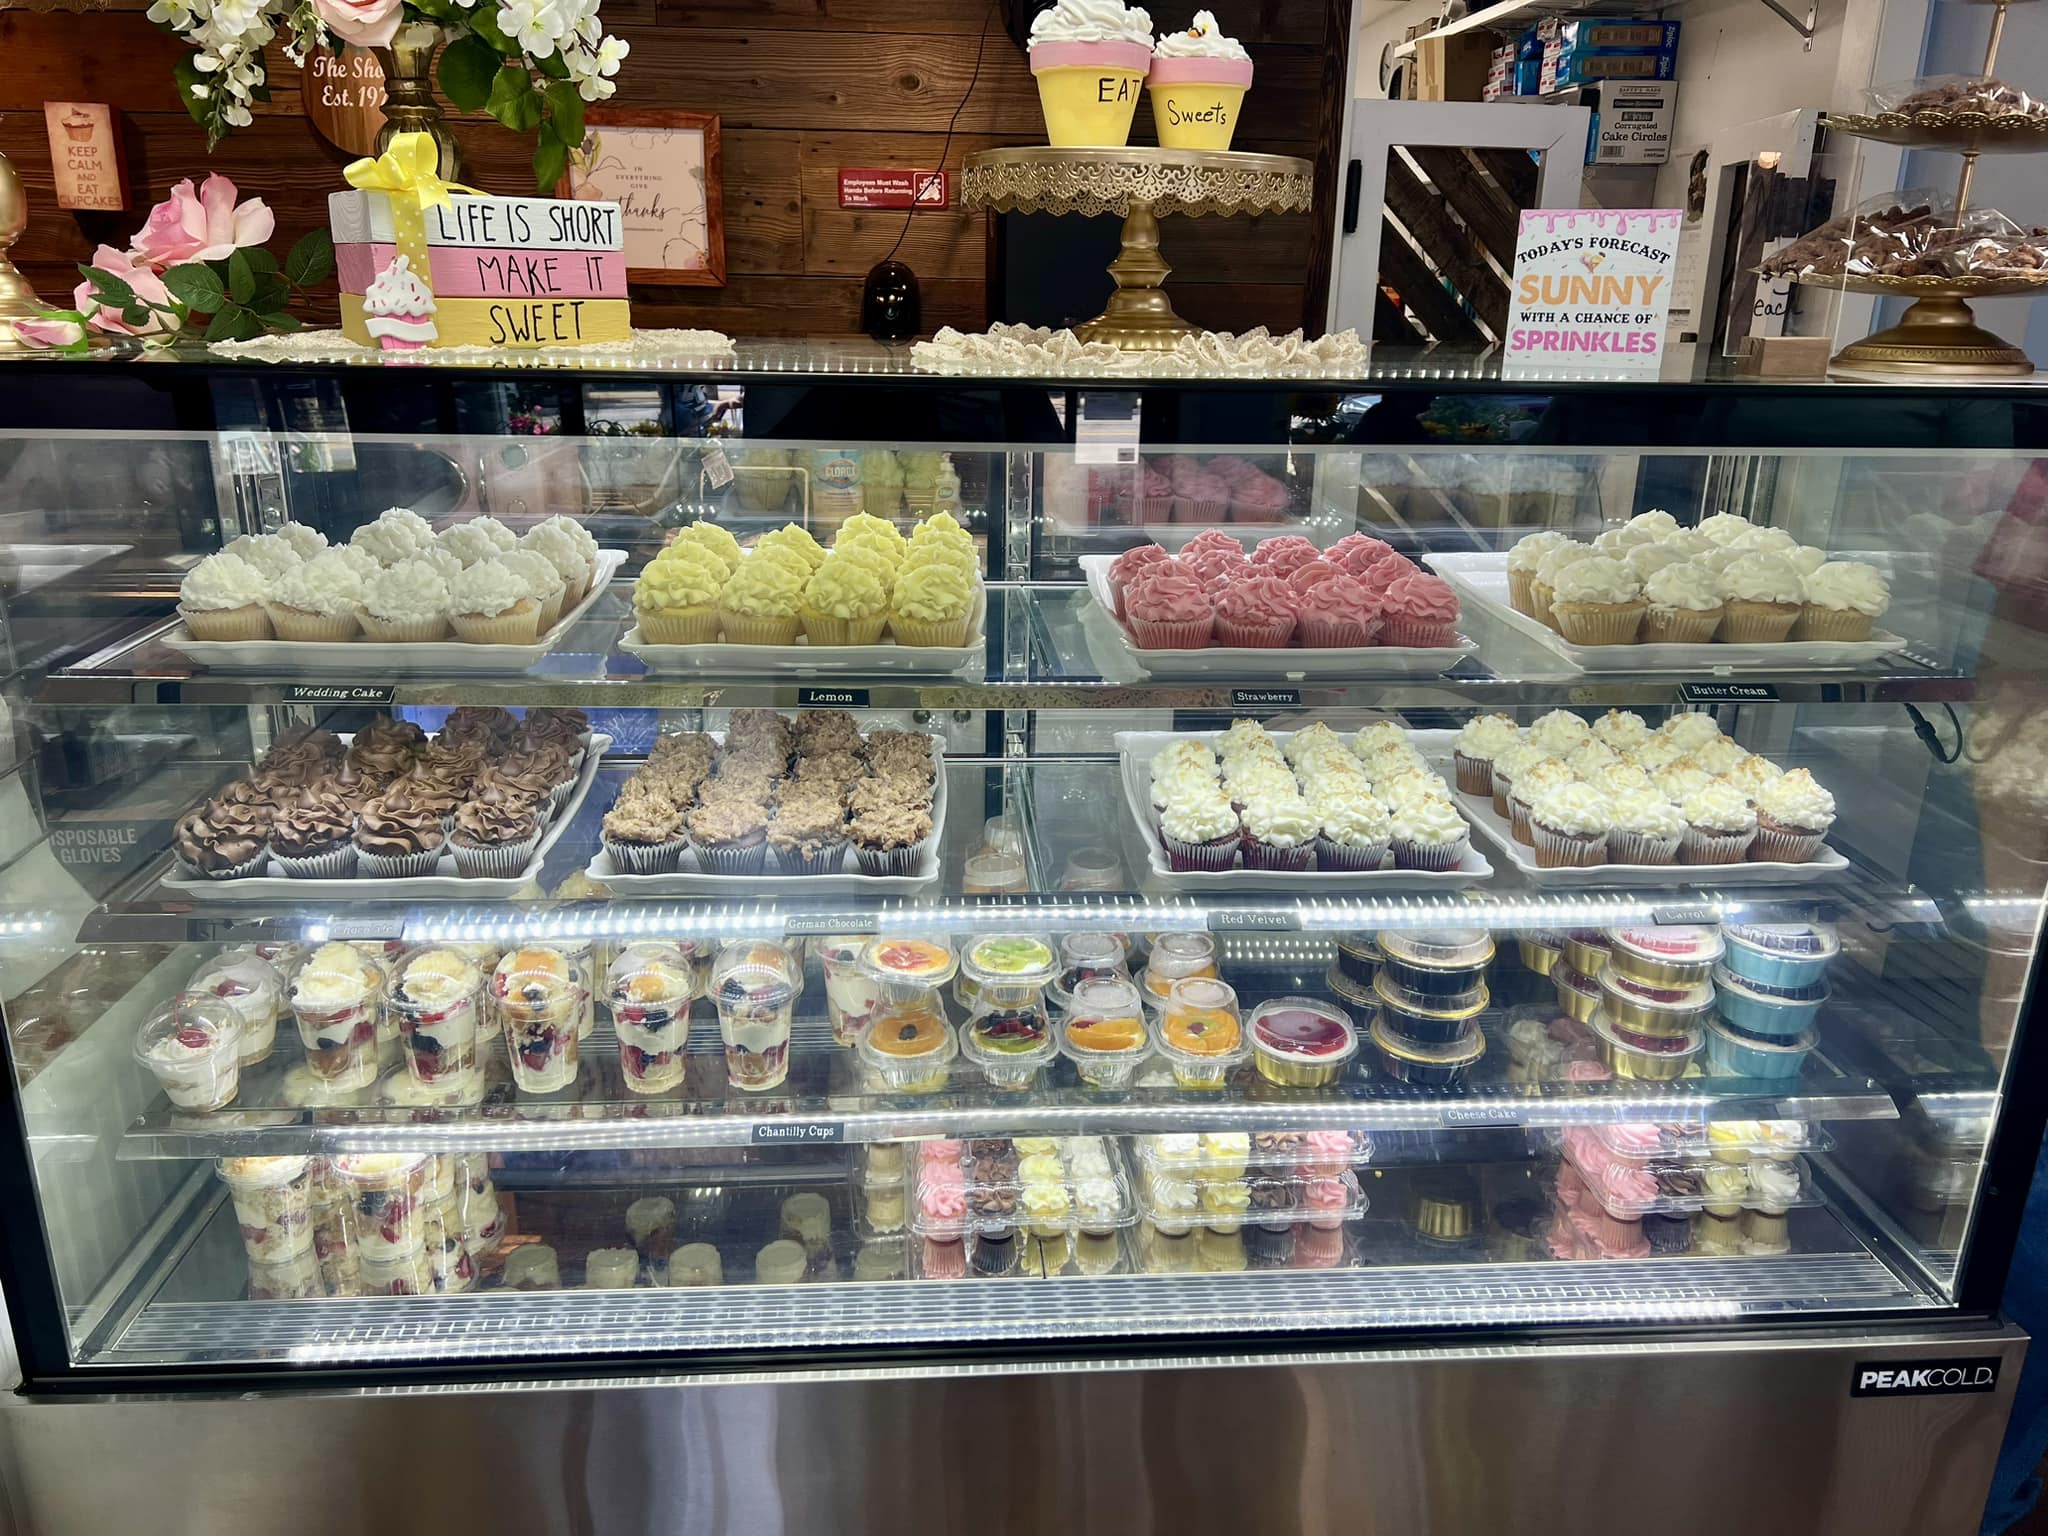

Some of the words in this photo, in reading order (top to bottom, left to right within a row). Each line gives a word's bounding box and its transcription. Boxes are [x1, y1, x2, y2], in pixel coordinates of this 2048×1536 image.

[1665, 25, 1676, 48] Ziploc
[312, 56, 347, 77] The
[321, 84, 354, 107] Est.
[1098, 77, 1140, 104] EAT
[1167, 99, 1227, 126] Sweets
[1614, 122, 1658, 131] Corrugated
[1602, 132, 1629, 141] Cake
[1631, 132, 1668, 141] Circles
[68, 146, 98, 157] KEEP
[67, 159, 103, 171] CALM
[77, 173, 97, 181] AND
[843, 179, 876, 187] Employees
[77, 184, 99, 195] EAT
[884, 188, 913, 196] Returning
[60, 195, 121, 207] CUPCAKES
[437, 204, 496, 242] LIFE
[506, 204, 531, 243] IS
[549, 205, 615, 245] SHORT
[1517, 237, 1584, 264] TODAY'S
[1589, 236, 1671, 265] FORECAST
[477, 254, 562, 296] MAKE
[585, 256, 604, 291] IT
[1517, 274, 1665, 306] SUNNY
[1753, 297, 1804, 317] eac
[489, 301, 585, 344] SWEET
[1520, 312, 1556, 323] WITH
[1559, 312, 1570, 323] A
[1575, 312, 1630, 324] CHANCE
[1635, 313, 1653, 324] OF
[1510, 329, 1657, 354] SPRINKLES
[294, 687, 349, 699] Wedding
[352, 687, 383, 698] Cake
[810, 691, 853, 702] Lemon
[1237, 691, 1294, 702] Strawberry
[1691, 685, 1728, 695] Butter
[1729, 685, 1768, 696] Cream
[60, 847, 122, 864] GLOVES
[1221, 913, 1243, 924] Red
[1247, 913, 1287, 924] Velvet
[1665, 909, 1705, 920] Carrot
[333, 921, 394, 936] Chocoate
[788, 918, 826, 929] German
[827, 918, 873, 928] Chocolate
[1447, 1109, 1487, 1120] Cheese
[1488, 1108, 1517, 1118] Cake
[758, 1125, 807, 1138] Chantilly
[808, 1125, 834, 1139] Cups
[1859, 1366, 1993, 1389] PEAKCOLD
